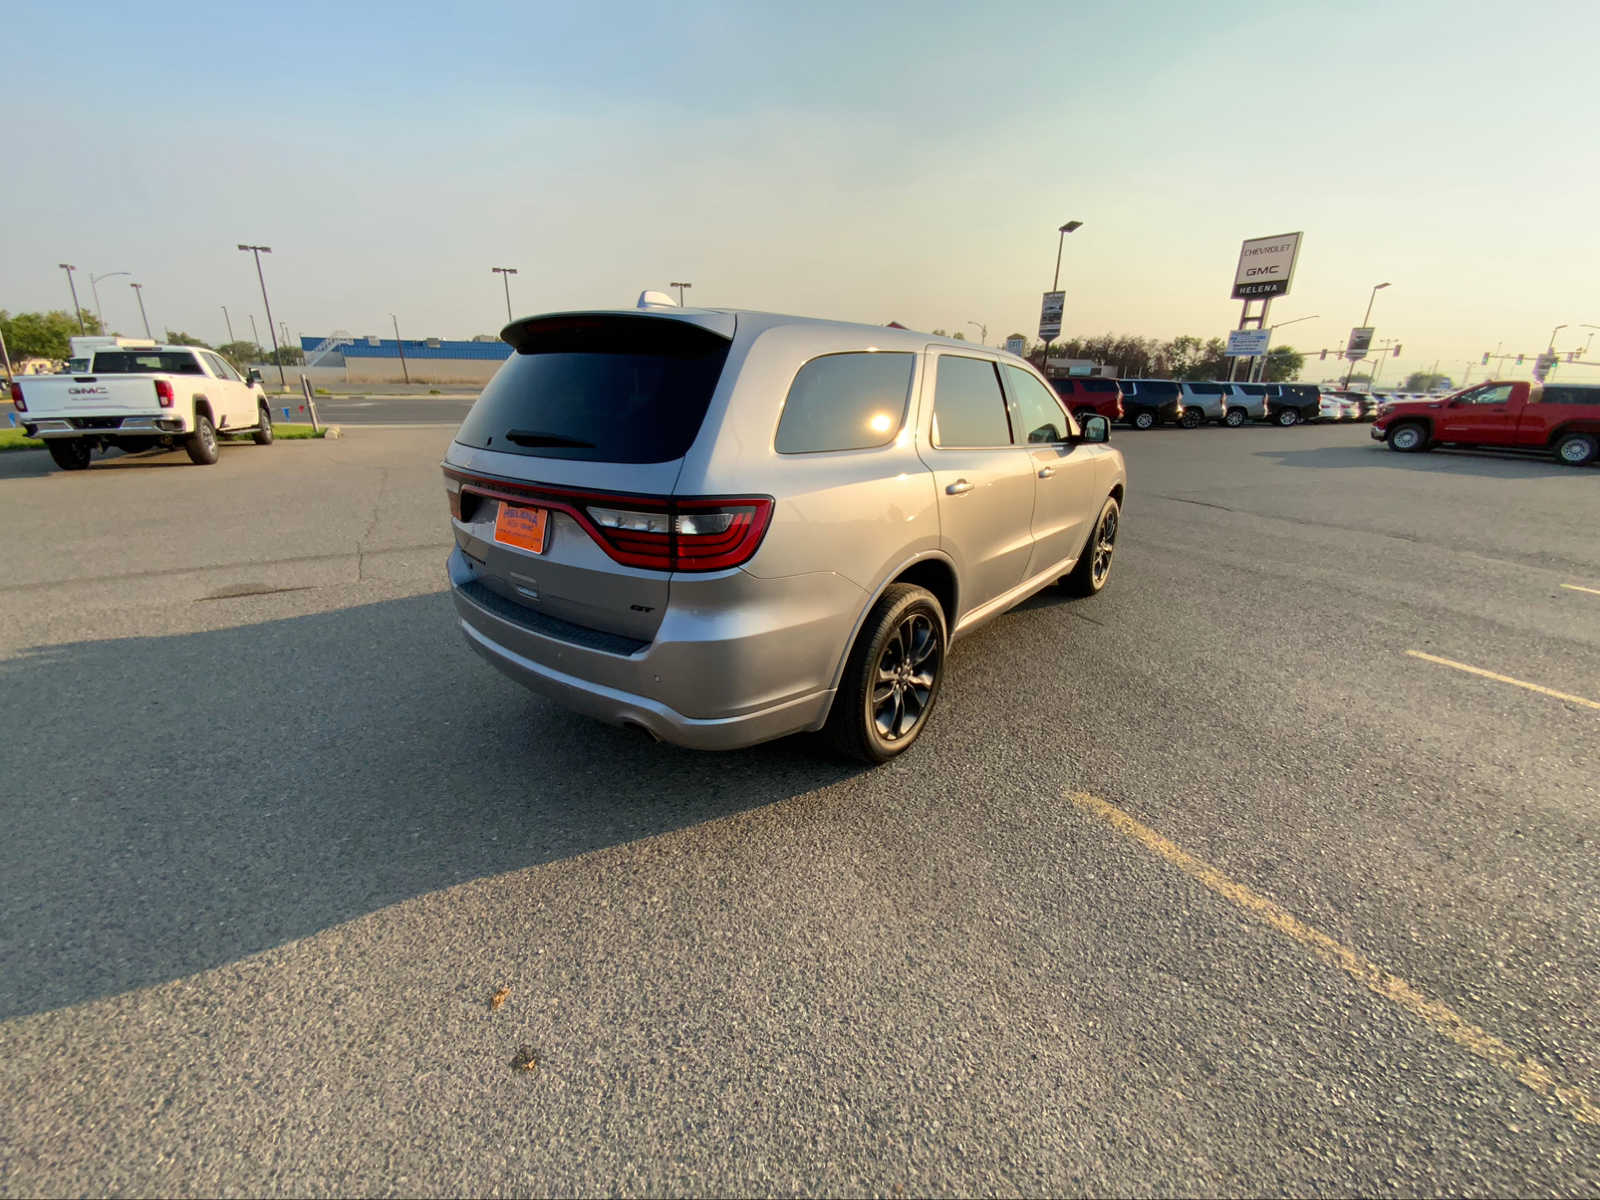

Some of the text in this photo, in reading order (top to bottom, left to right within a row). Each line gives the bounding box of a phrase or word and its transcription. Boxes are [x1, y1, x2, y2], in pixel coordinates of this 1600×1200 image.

[1244, 244, 1291, 257] CHEVROLET
[1246, 265, 1280, 277] GMC
[1239, 284, 1278, 295] HELENA
[68, 386, 108, 395] GMC
[630, 604, 655, 614] GT
